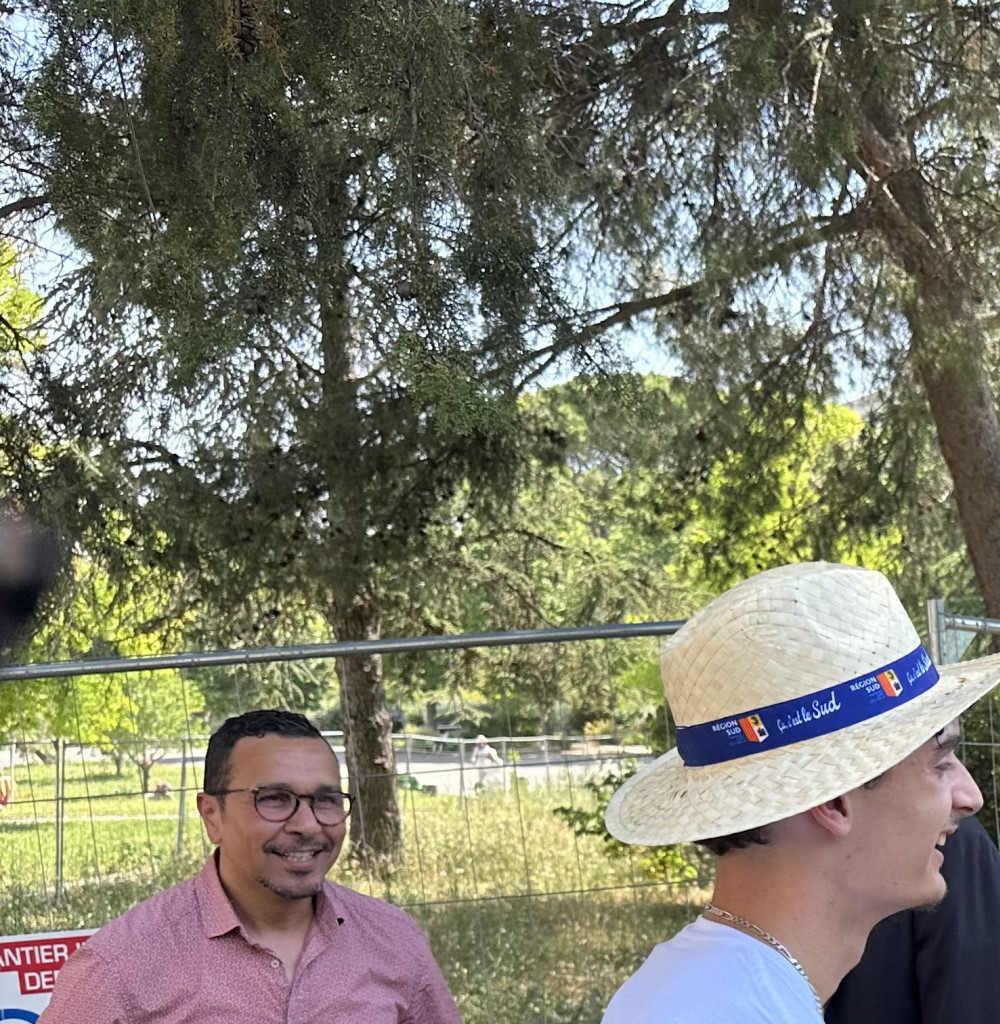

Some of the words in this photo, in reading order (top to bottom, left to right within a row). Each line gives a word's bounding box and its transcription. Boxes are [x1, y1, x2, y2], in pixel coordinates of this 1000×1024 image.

[865, 683, 881, 693] SUD
[801, 706, 812, 722] le
[812, 690, 841, 719] Sud
[726, 726, 742, 736] SUD
